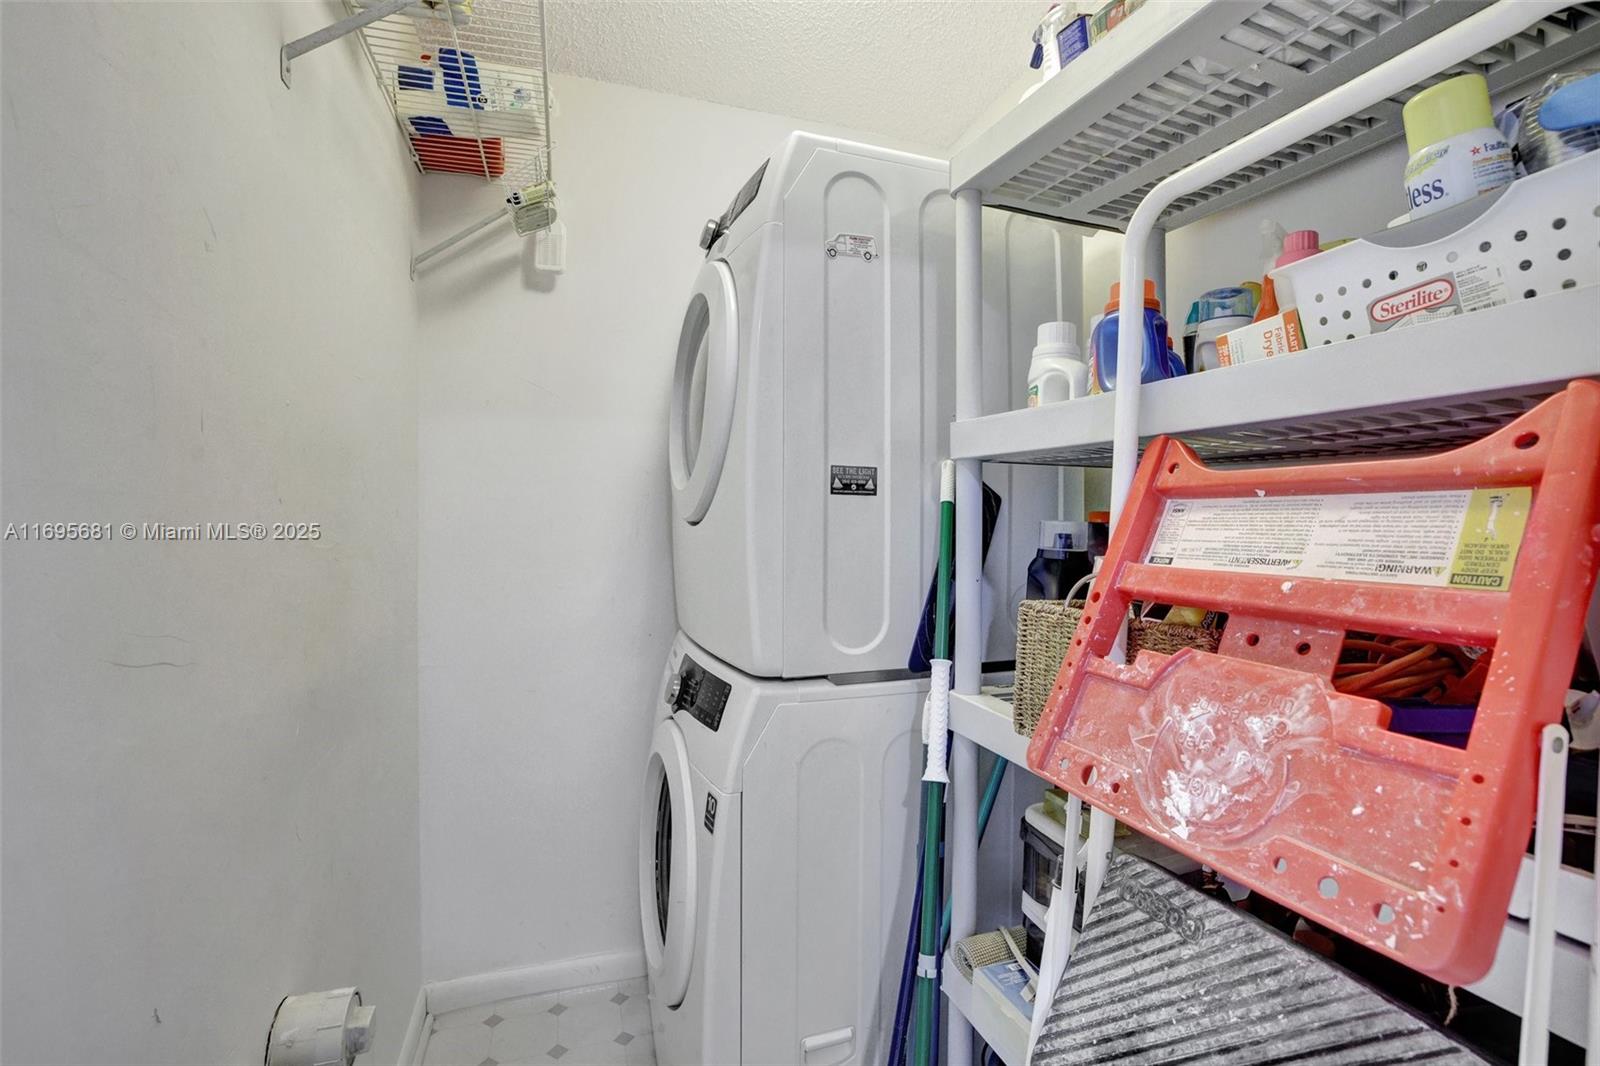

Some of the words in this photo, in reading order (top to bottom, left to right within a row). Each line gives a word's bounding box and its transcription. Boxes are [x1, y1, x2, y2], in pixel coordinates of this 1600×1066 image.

[1379, 289, 1443, 318] Sterilite
[1274, 326, 1285, 354] Fabric
[1286, 322, 1299, 351] SMART
[1374, 563, 1433, 576] WARNING!
[1452, 574, 1501, 587] CAUTION
